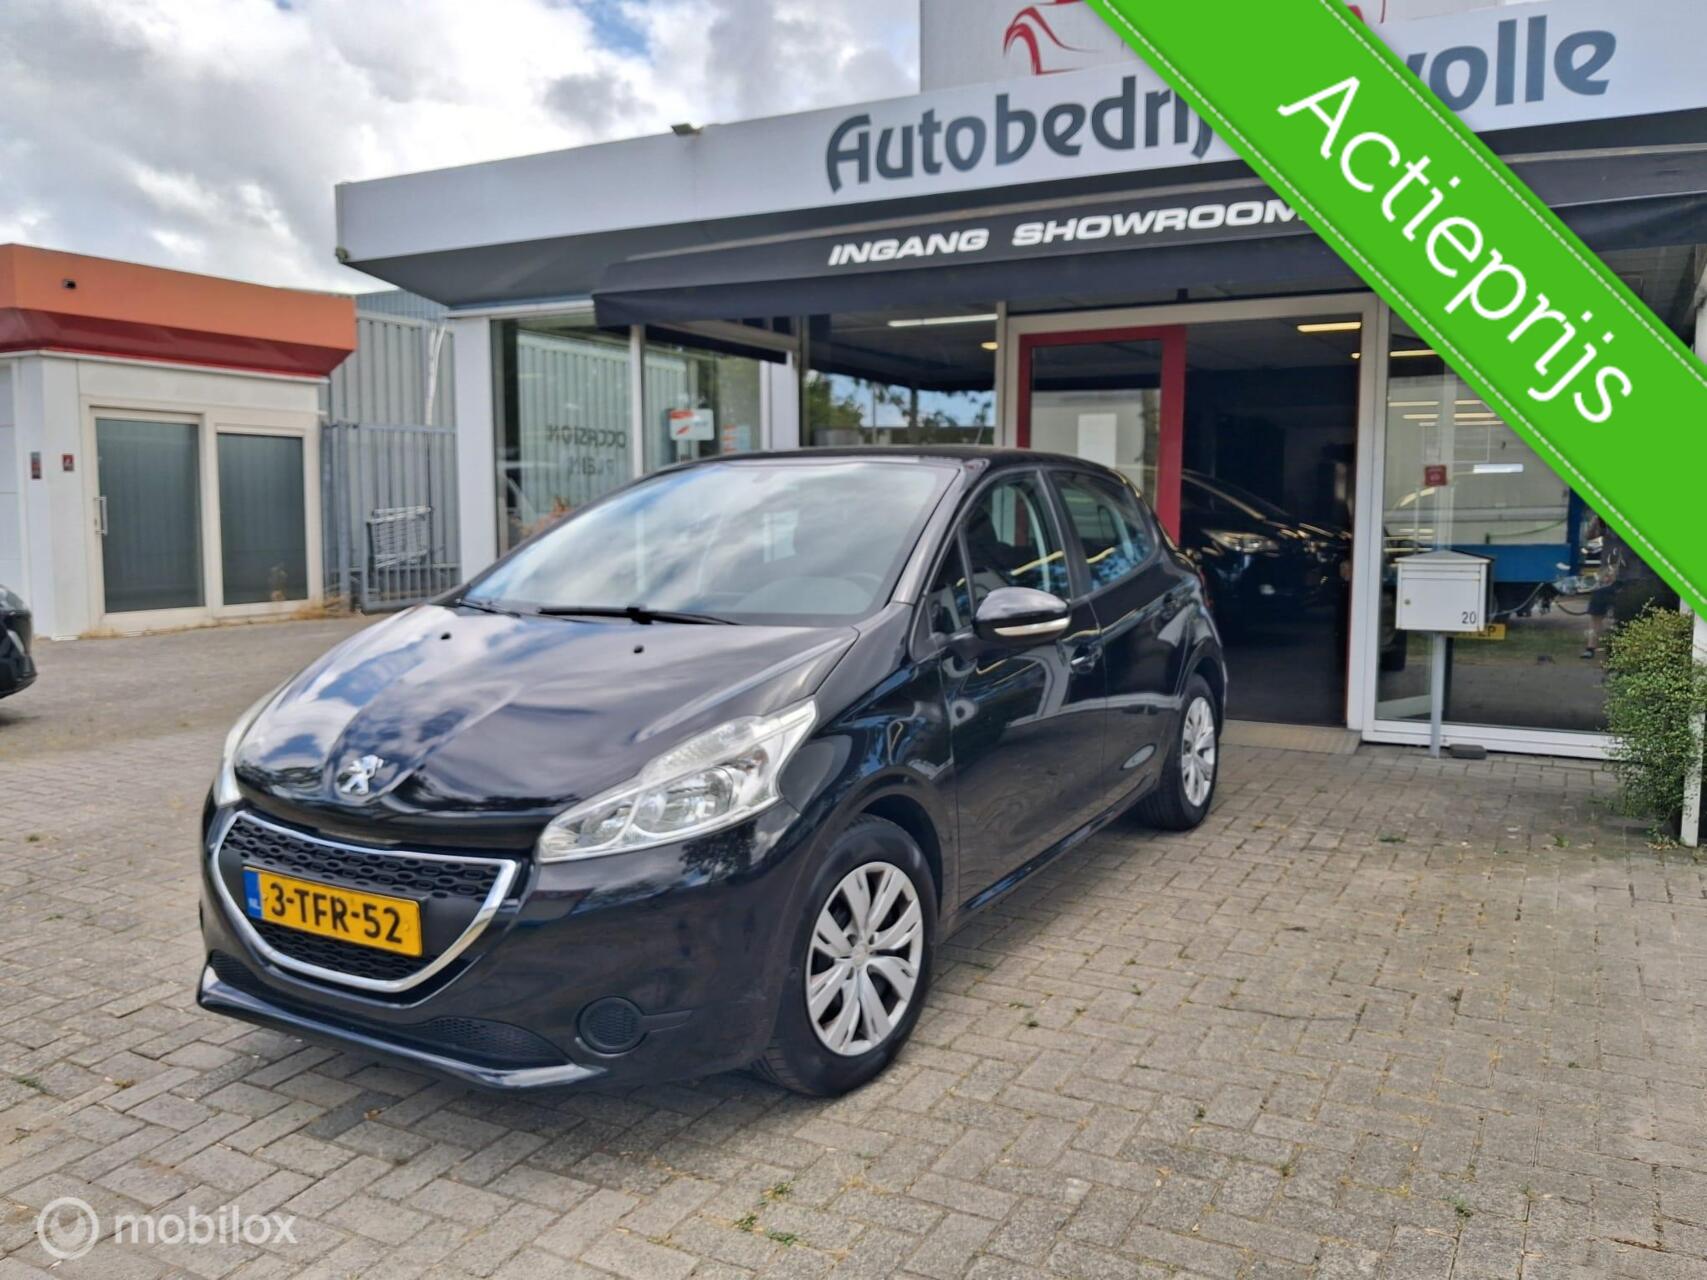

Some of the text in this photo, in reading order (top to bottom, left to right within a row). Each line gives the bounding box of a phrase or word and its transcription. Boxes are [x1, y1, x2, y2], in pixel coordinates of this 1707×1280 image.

[828, 199, 1304, 266] INGANG SHOWROOM
[1461, 611, 1477, 625] 20
[270, 881, 403, 945] 3-TFR-52
